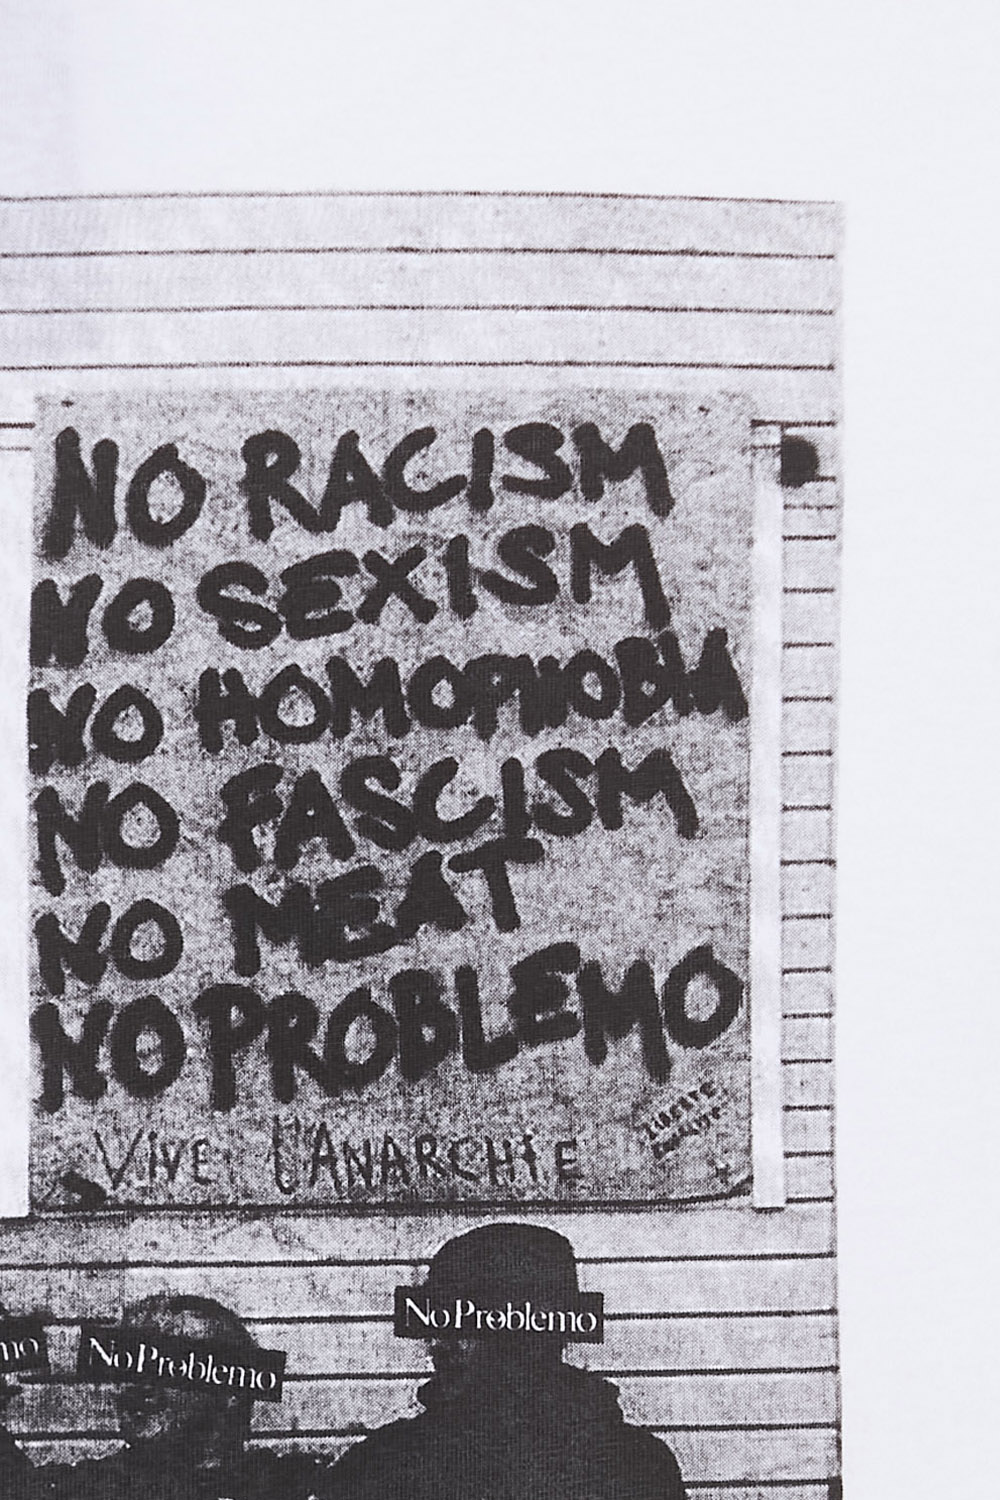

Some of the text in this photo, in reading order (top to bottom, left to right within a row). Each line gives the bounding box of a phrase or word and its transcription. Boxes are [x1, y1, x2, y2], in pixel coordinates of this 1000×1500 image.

[41, 422, 674, 561] NO RACISM
[30, 522, 671, 667] NO SEXISM
[27, 682, 164, 774] NO
[32, 748, 699, 897] NO FASCISM
[34, 837, 544, 995] NO MEAT
